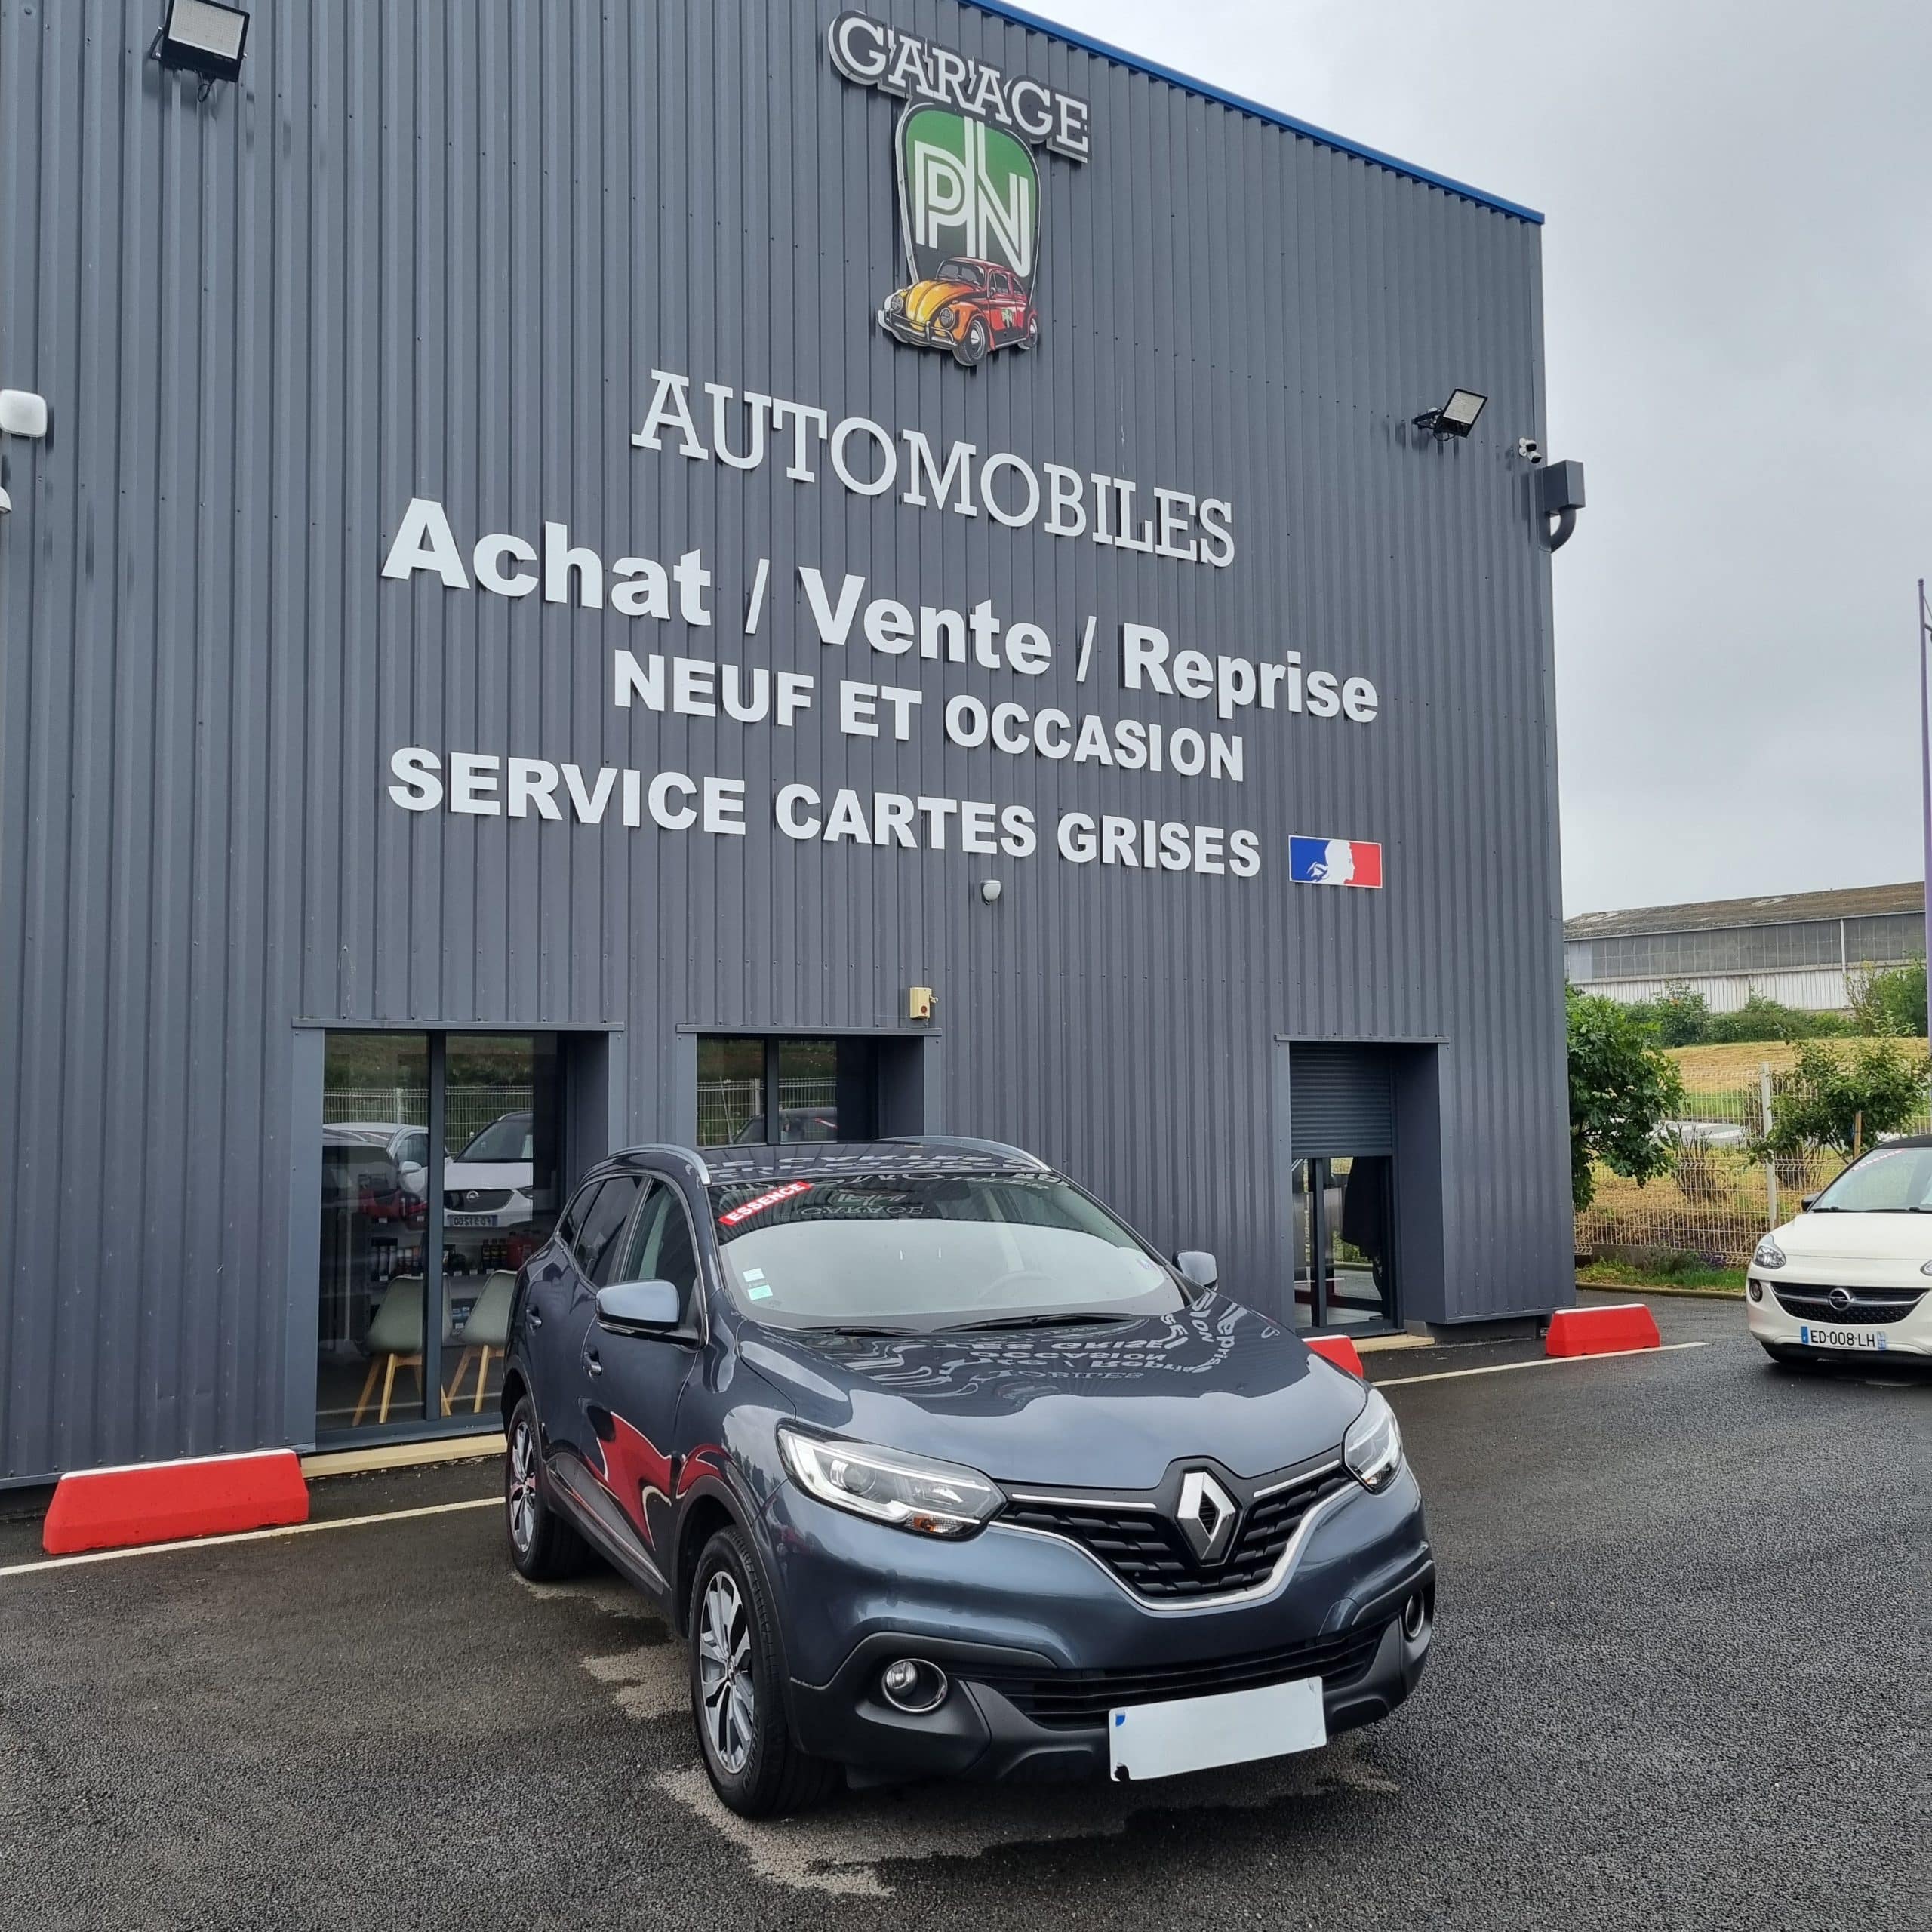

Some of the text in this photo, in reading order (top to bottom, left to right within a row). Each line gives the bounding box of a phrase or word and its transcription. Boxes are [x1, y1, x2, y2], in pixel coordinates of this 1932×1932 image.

[839, 17, 1088, 152] GARAGE
[632, 368, 1235, 568] AUTOMOBILES
[381, 497, 1378, 723] Achat / Vente / Reprise
[614, 649, 1244, 782] NEUF ET OCCASION
[388, 747, 1260, 877] SERVICE CARTES GRISES
[726, 1181, 808, 1223] ESSENCE
